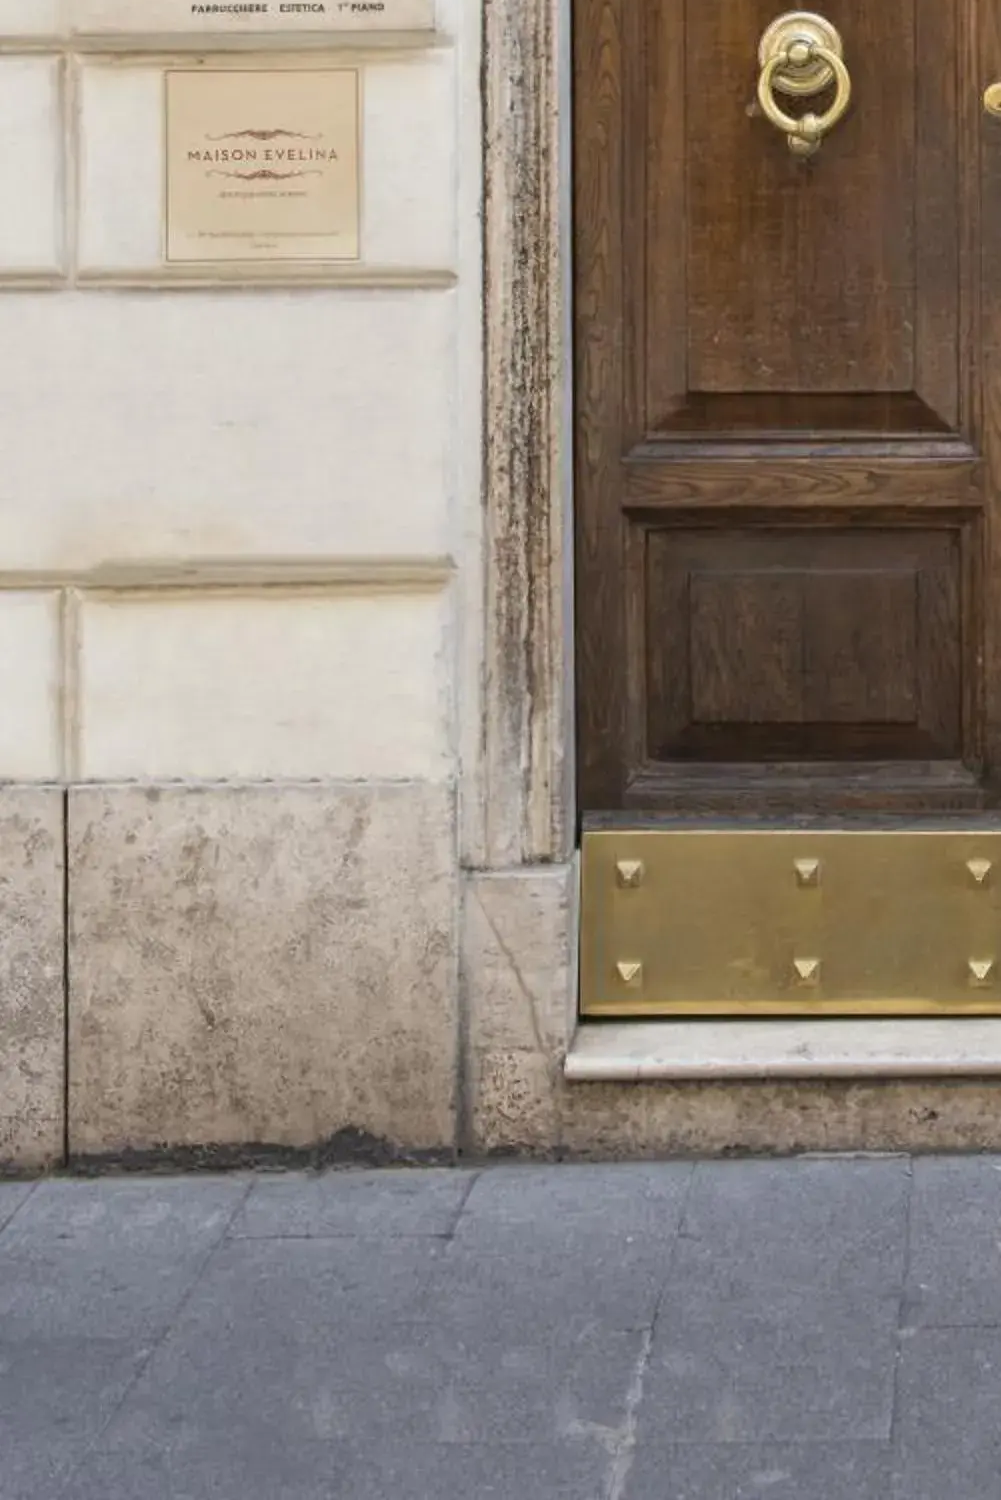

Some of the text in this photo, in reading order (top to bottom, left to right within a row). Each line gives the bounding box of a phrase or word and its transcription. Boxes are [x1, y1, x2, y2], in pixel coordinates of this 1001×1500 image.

[279, 3, 325, 13] ESTETICA
[350, 2, 385, 12] PIANO
[187, 148, 339, 161] MAISON EVELINA
